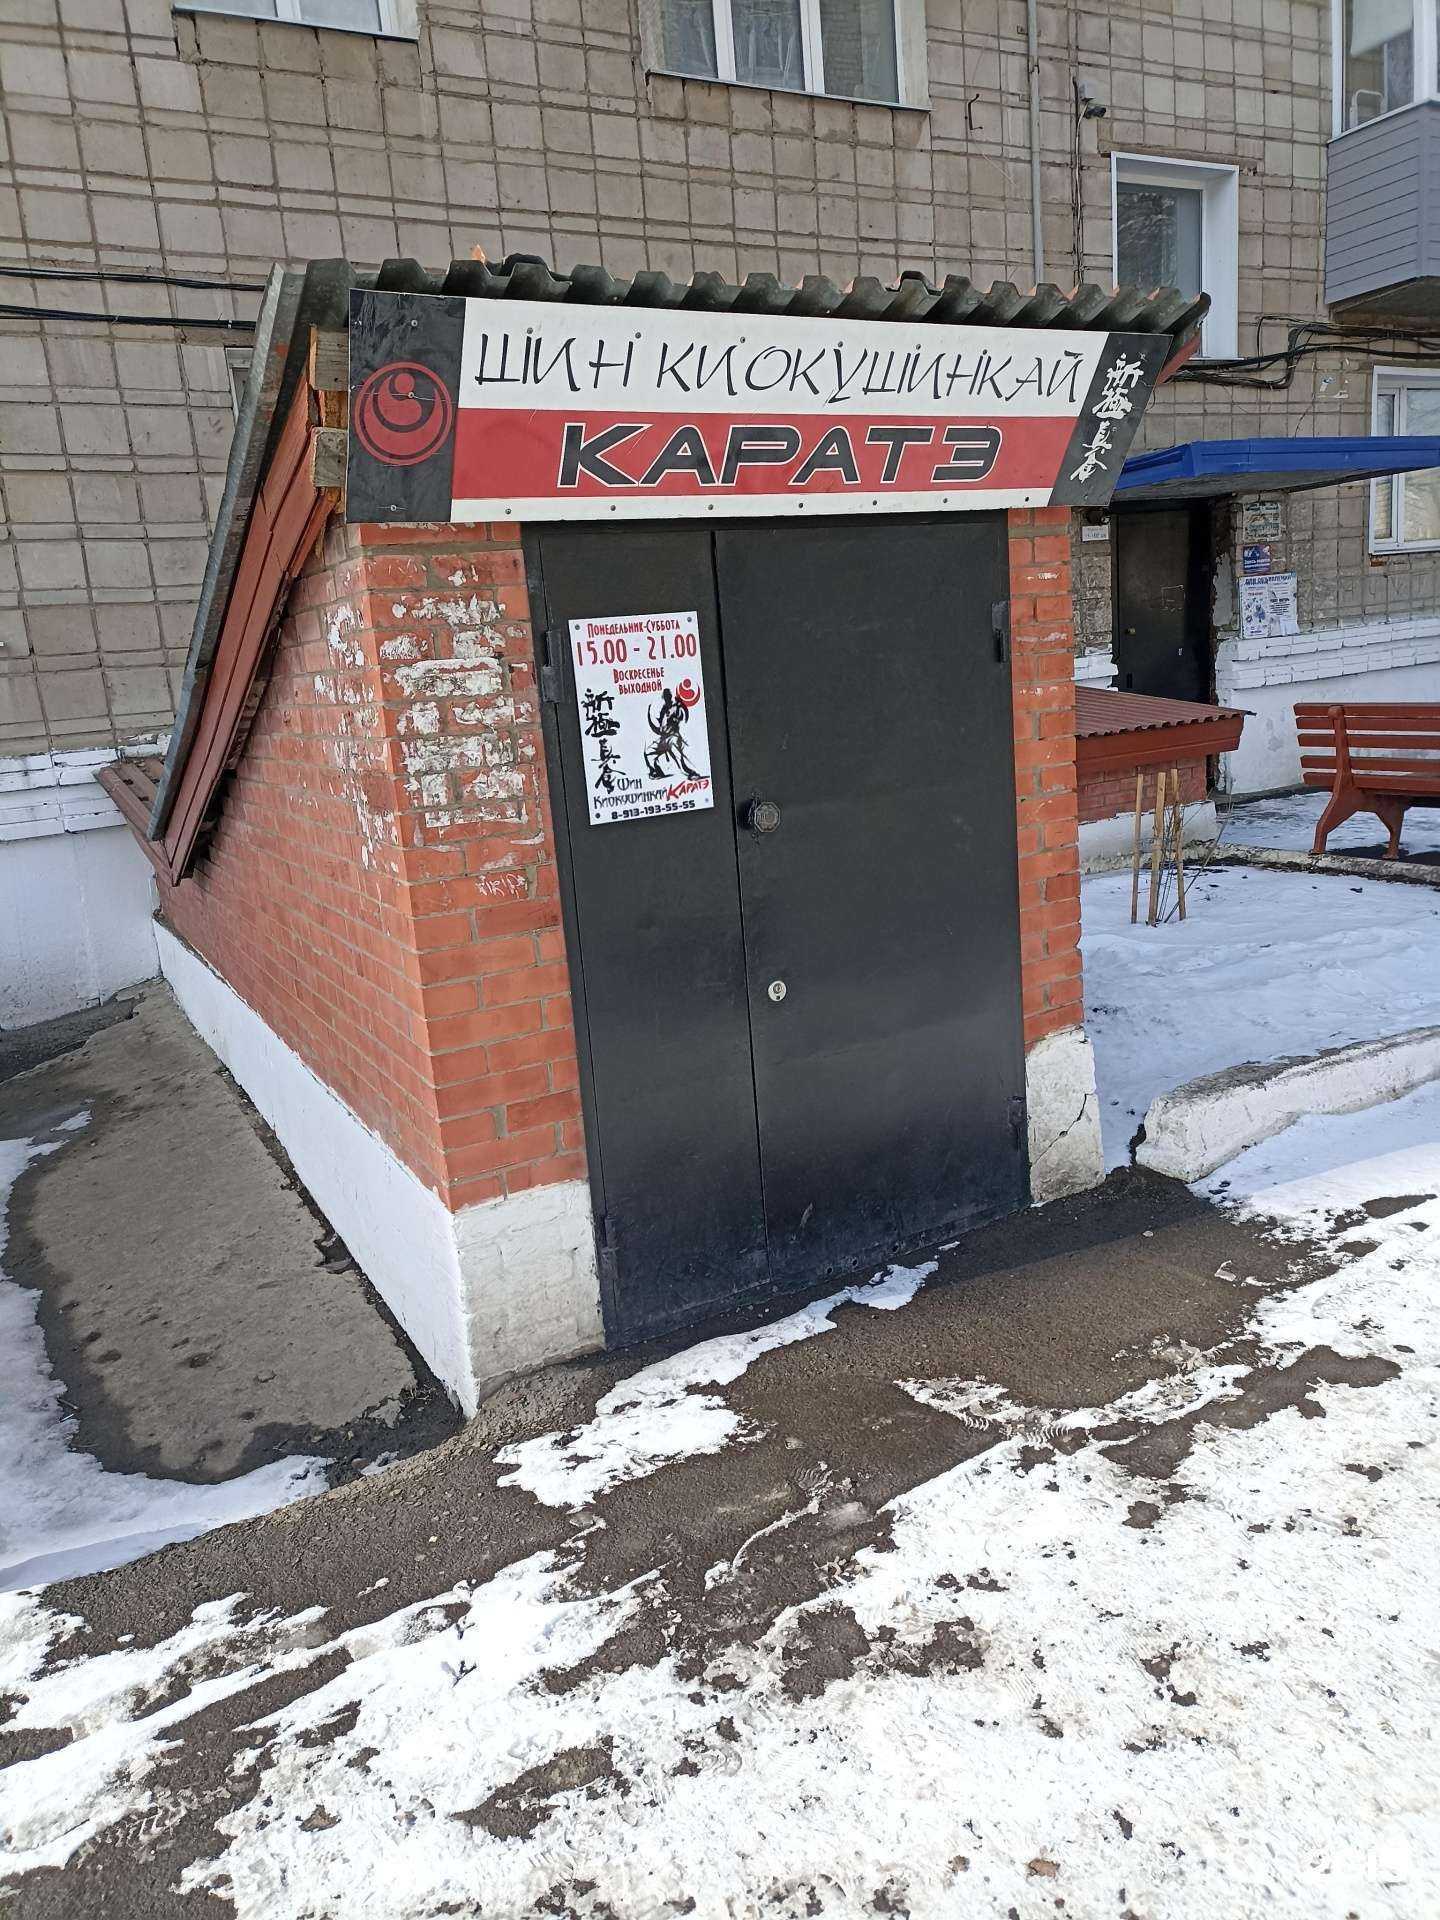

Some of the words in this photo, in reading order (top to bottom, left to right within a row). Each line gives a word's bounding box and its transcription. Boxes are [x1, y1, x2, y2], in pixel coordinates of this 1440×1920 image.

[475, 332, 634, 392] ШИН
[656, 341, 1085, 407] КИОКУШИНКАЙ
[556, 421, 1004, 489] КАРАТЭ
[576, 638, 629, 666] 15.00
[646, 633, 697, 660] 21.00
[611, 800, 696, 819] 8-913-193-55-55
